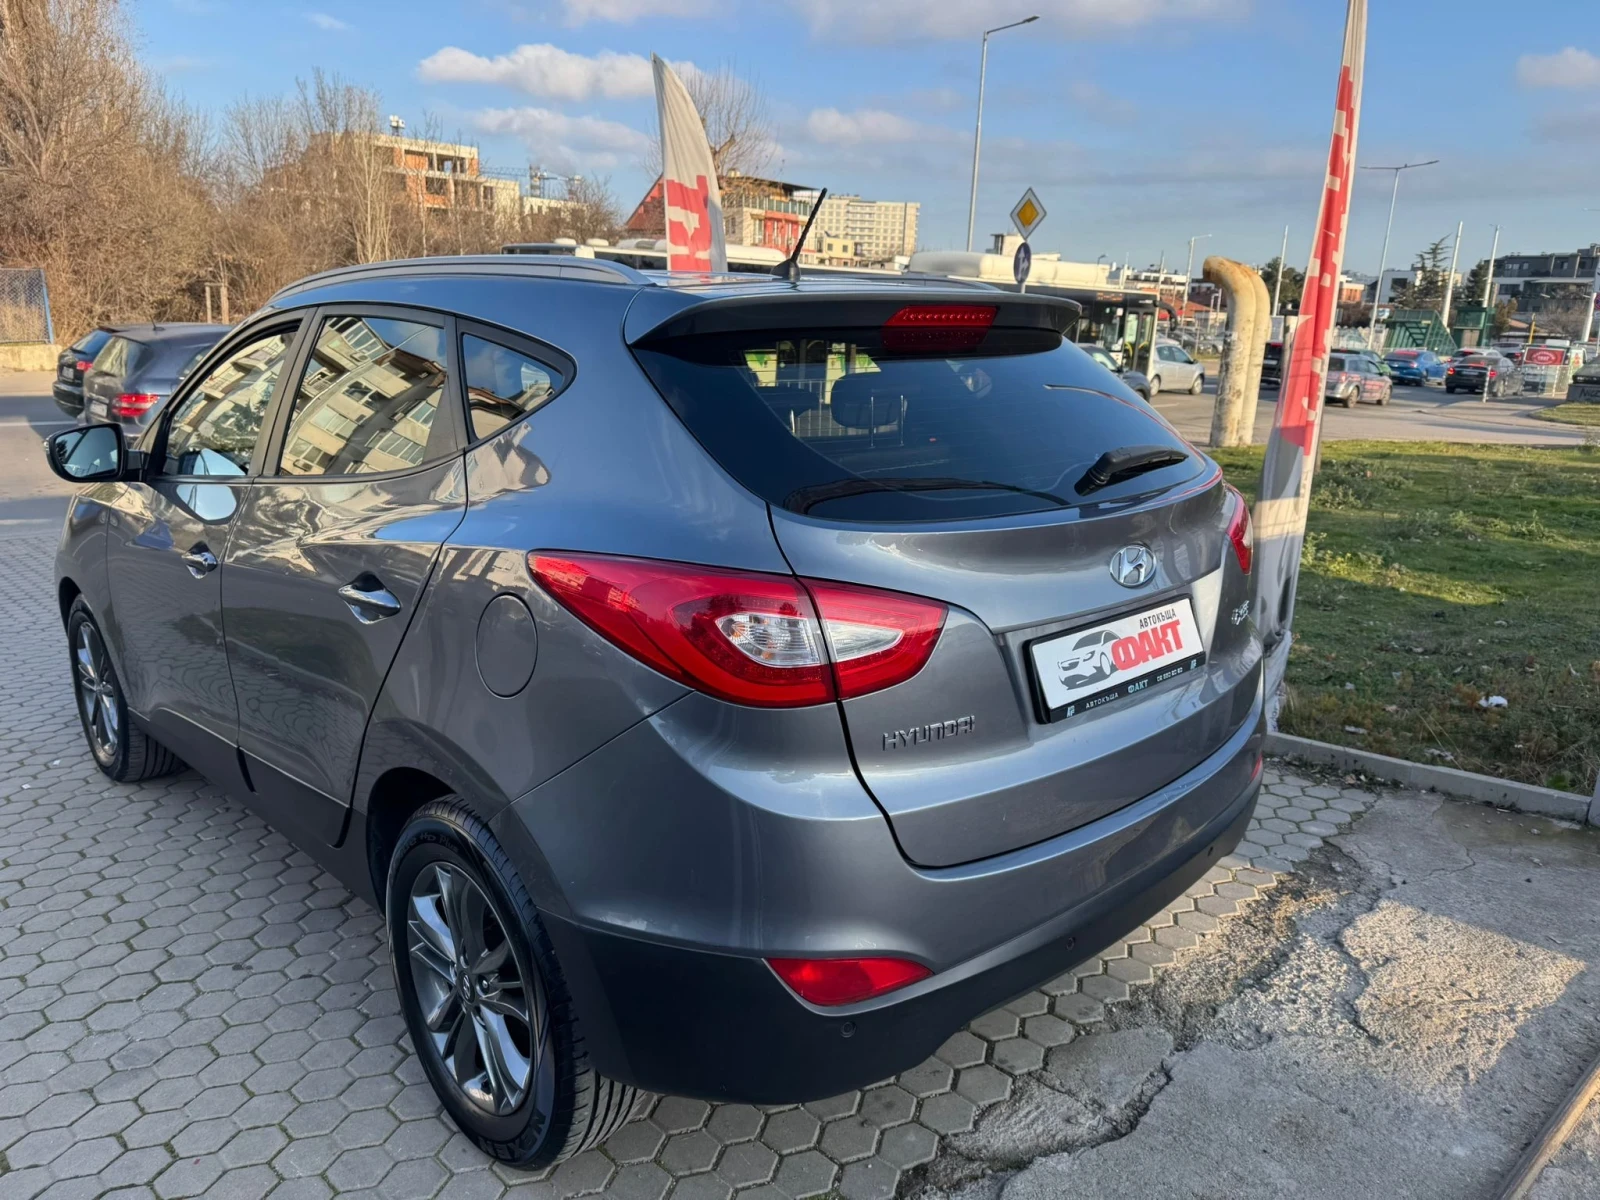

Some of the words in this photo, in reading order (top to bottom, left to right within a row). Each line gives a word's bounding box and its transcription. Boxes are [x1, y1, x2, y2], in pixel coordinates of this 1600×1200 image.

[1139, 608, 1177, 630] АВТОКЪЩА
[1111, 619, 1184, 671] ФАКТ
[1127, 679, 1149, 694] ФАКТ
[882, 714, 976, 751] HYUNDAI
